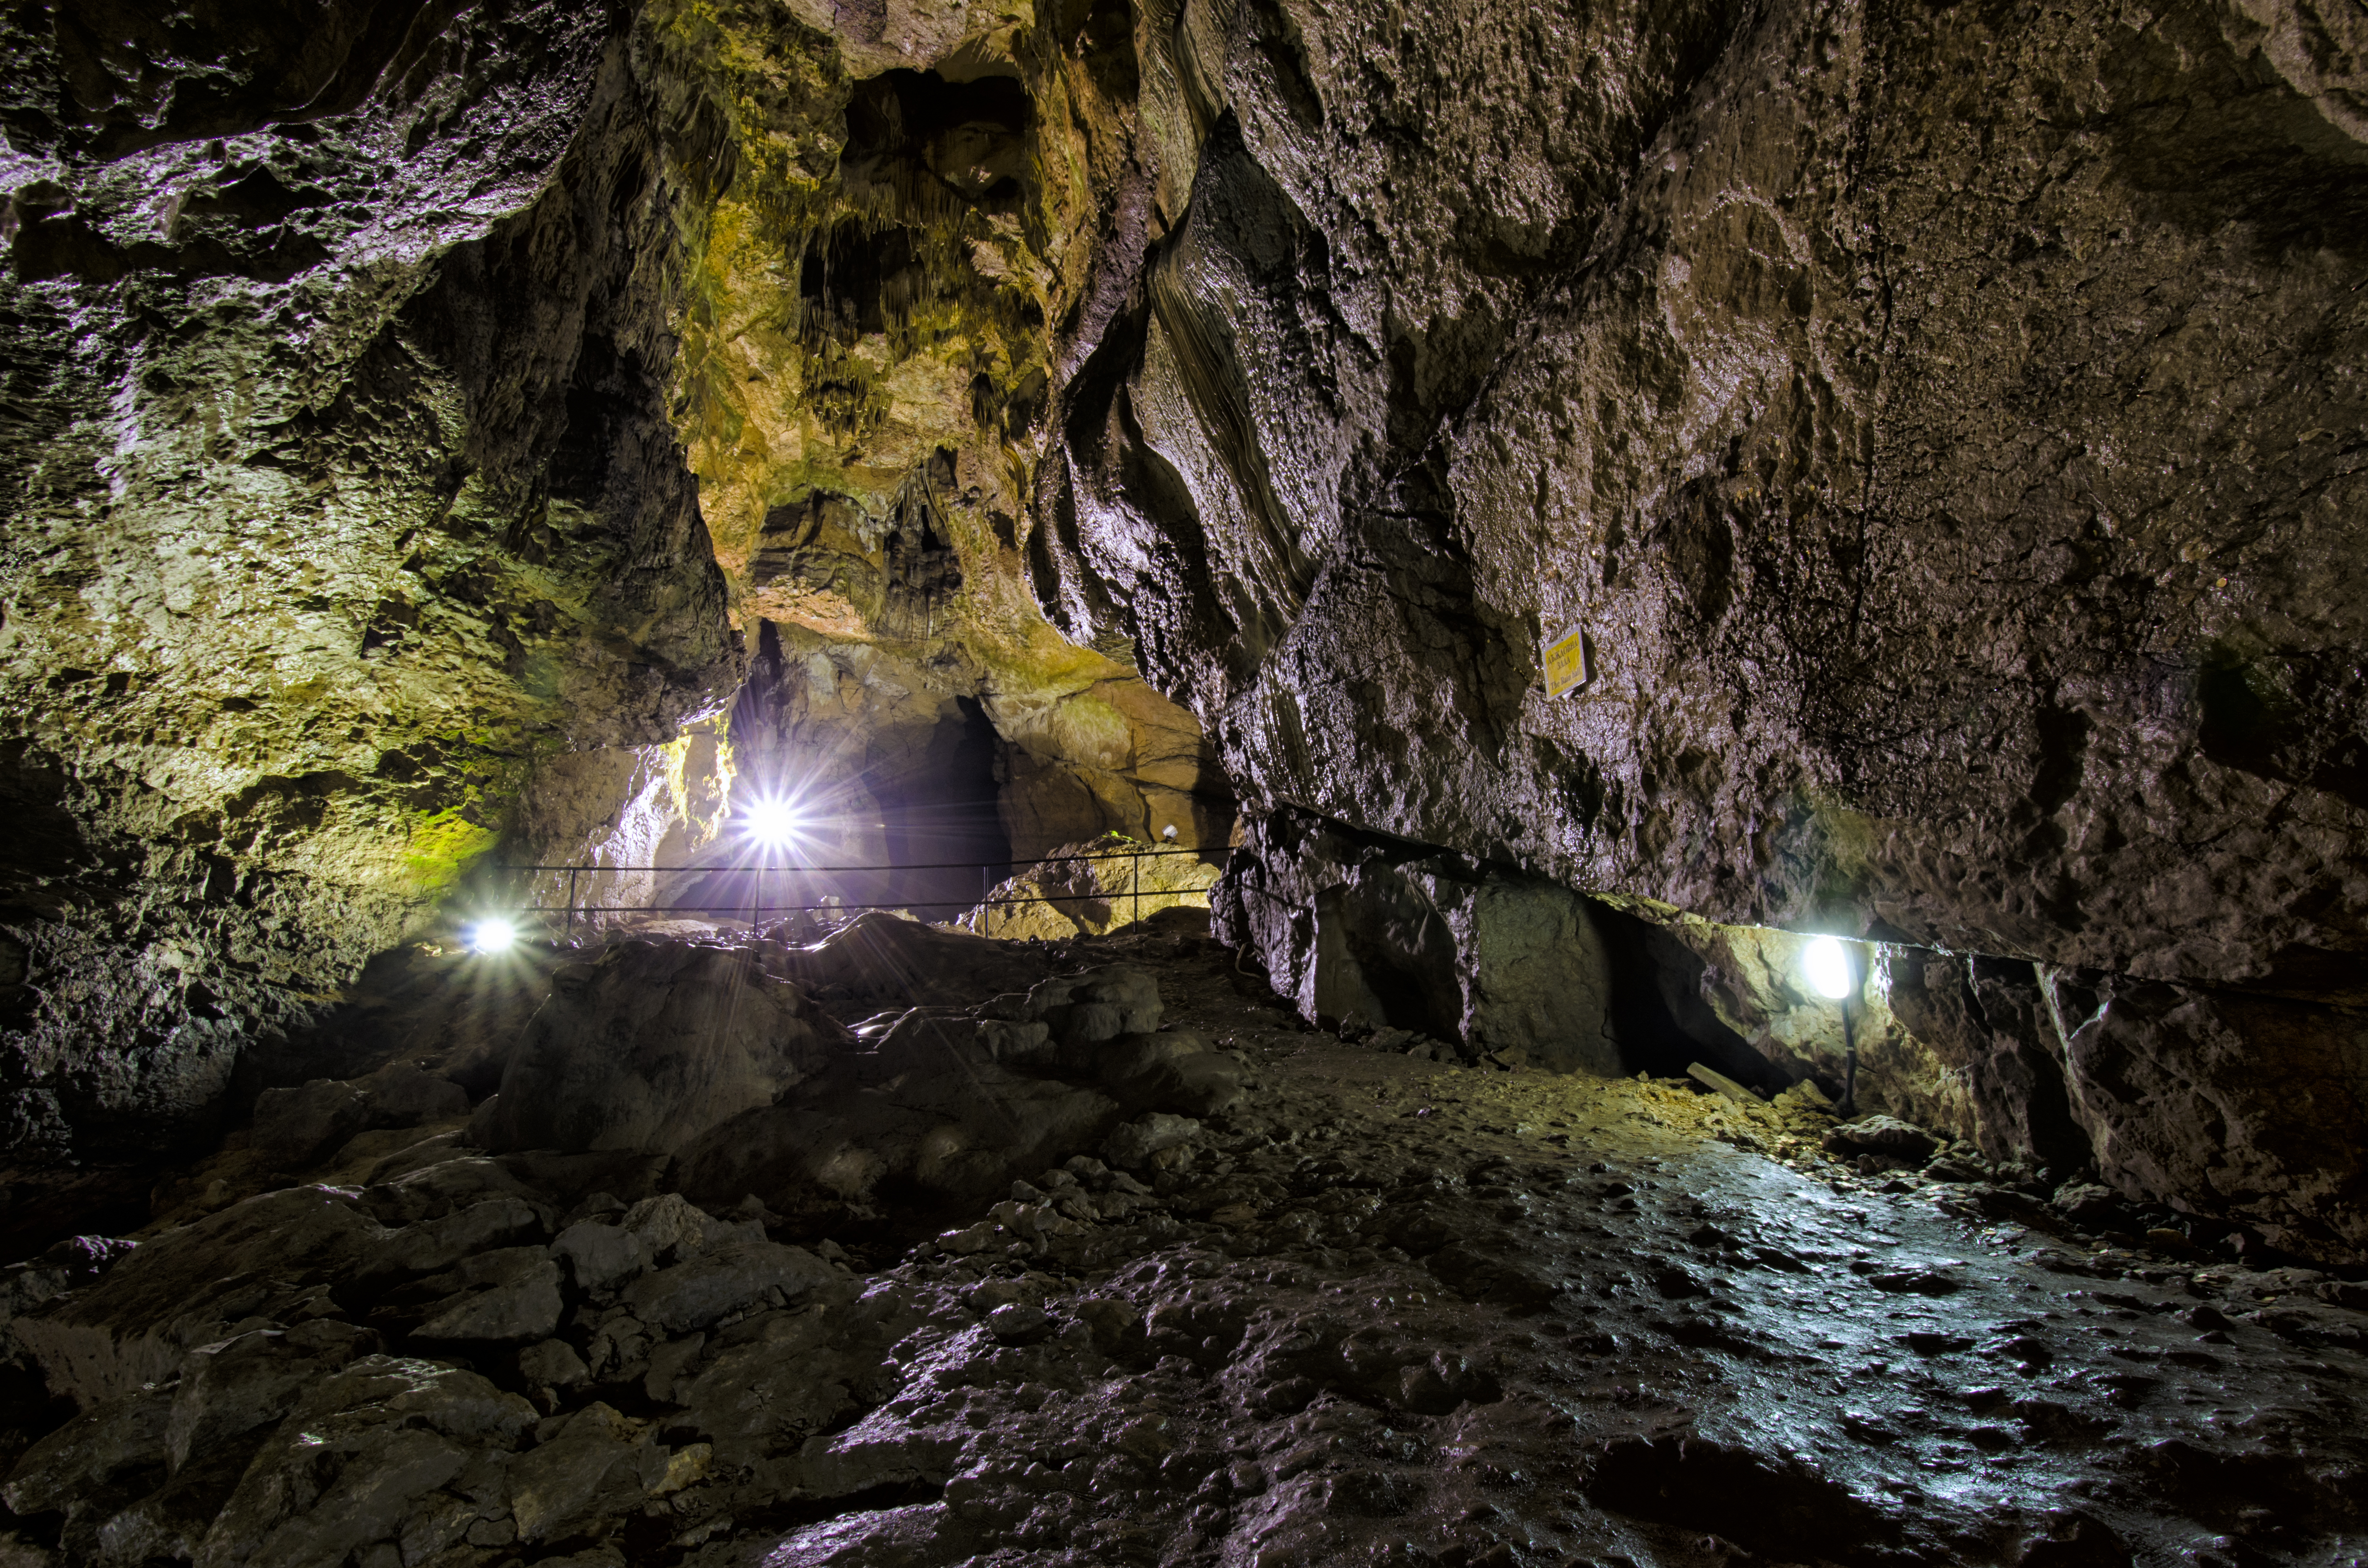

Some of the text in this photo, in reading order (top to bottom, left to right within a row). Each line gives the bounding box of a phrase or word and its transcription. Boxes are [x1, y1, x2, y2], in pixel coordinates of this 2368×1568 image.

[1557, 656, 1571, 670] ЗАЛА
[1551, 666, 1580, 690] The Rain hall
